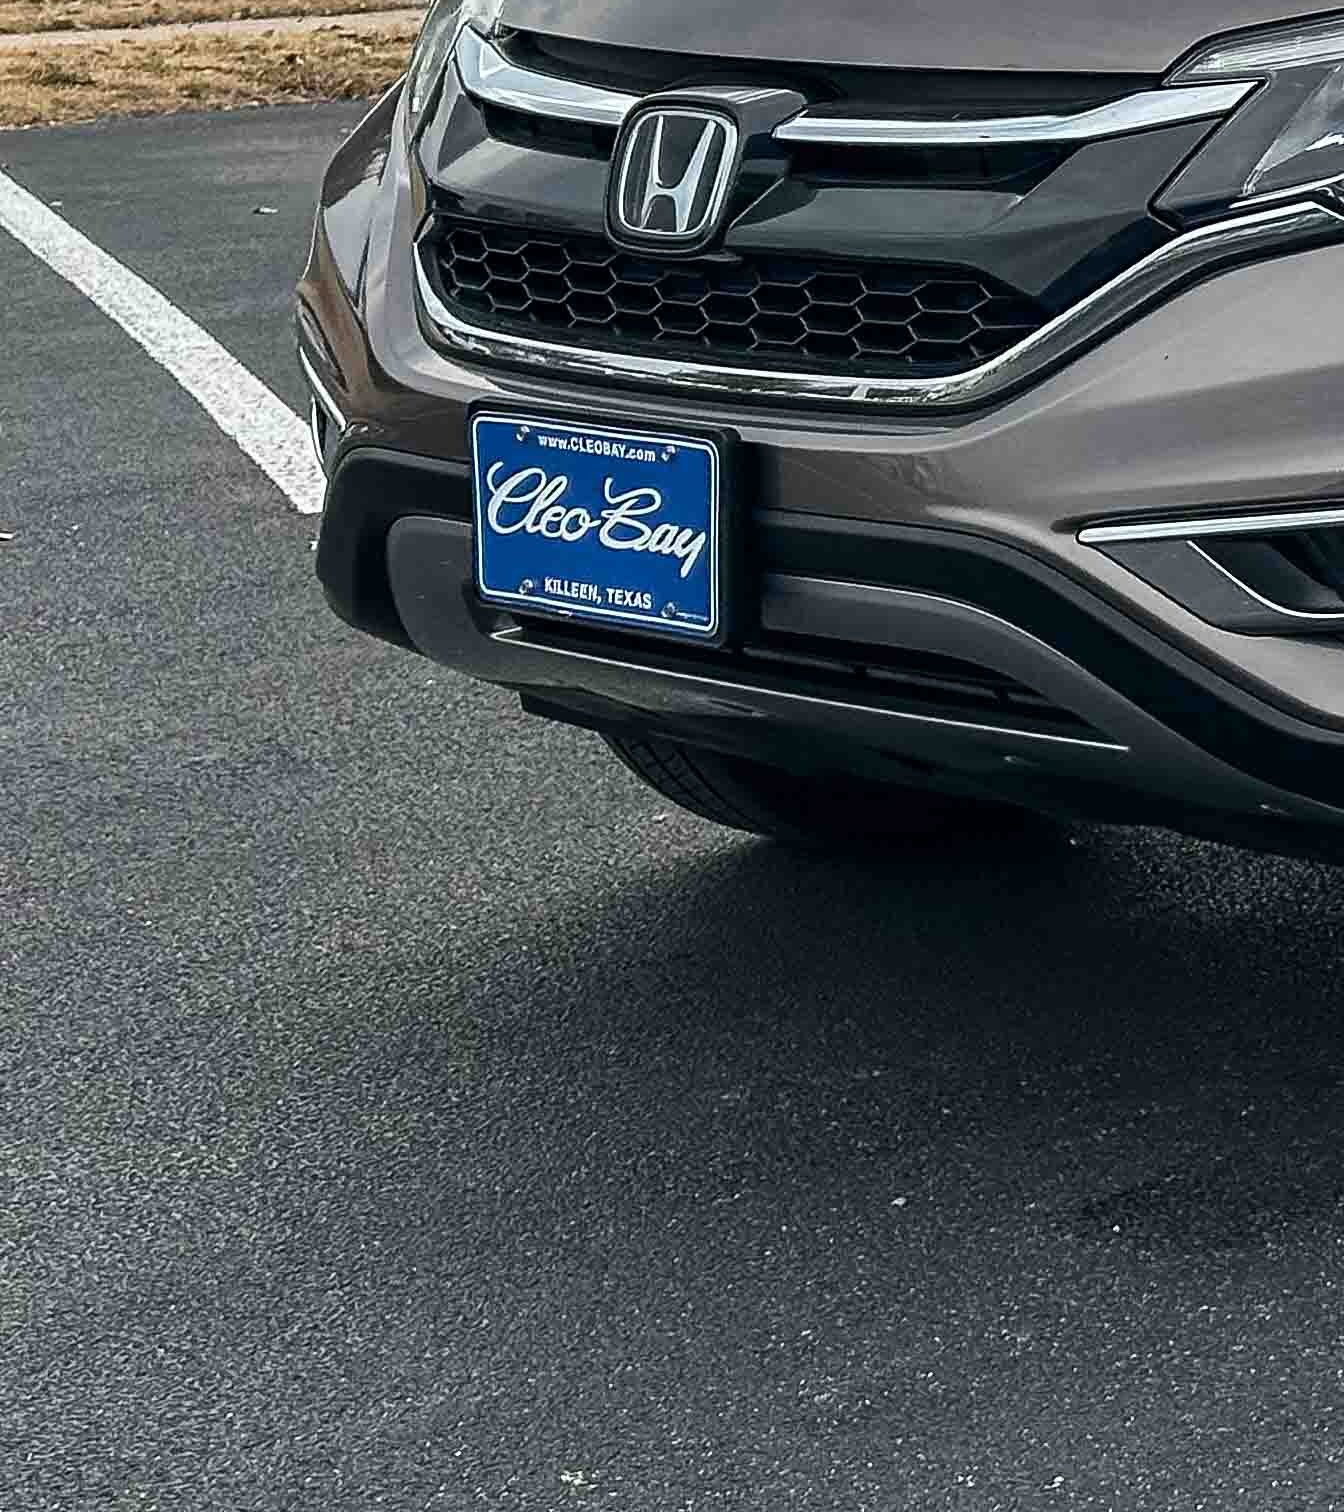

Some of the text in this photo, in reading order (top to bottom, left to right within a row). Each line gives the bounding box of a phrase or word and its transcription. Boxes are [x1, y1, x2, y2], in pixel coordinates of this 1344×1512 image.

[537, 435, 656, 462] www.CLEOBAY.com
[487, 461, 706, 579] Cleo Bay
[543, 576, 653, 609] KILLEEN, TEXAS
